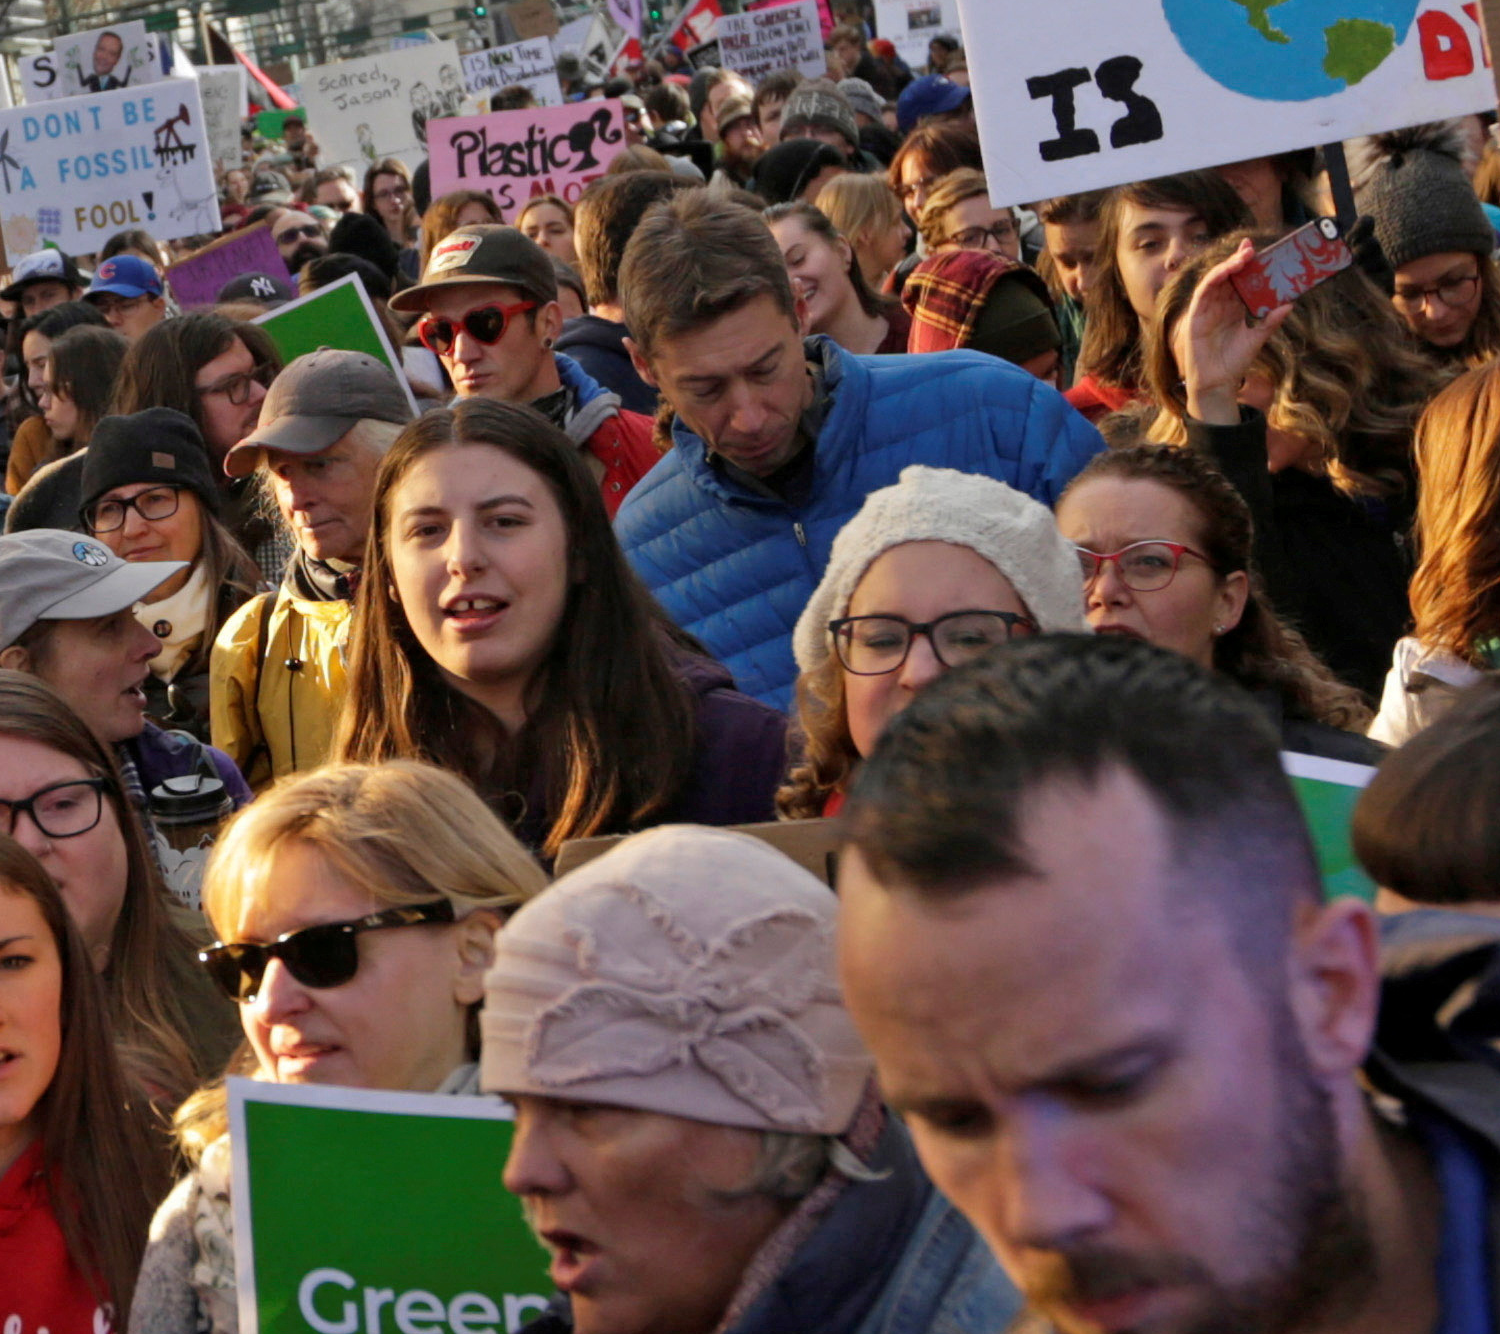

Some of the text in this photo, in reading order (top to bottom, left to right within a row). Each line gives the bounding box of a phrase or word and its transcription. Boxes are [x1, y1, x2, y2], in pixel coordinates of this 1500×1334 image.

[122, 98, 156, 126] BE
[1026, 54, 1163, 161] IS
[20, 145, 154, 191] A FOSSIL
[450, 124, 571, 178] Plastic
